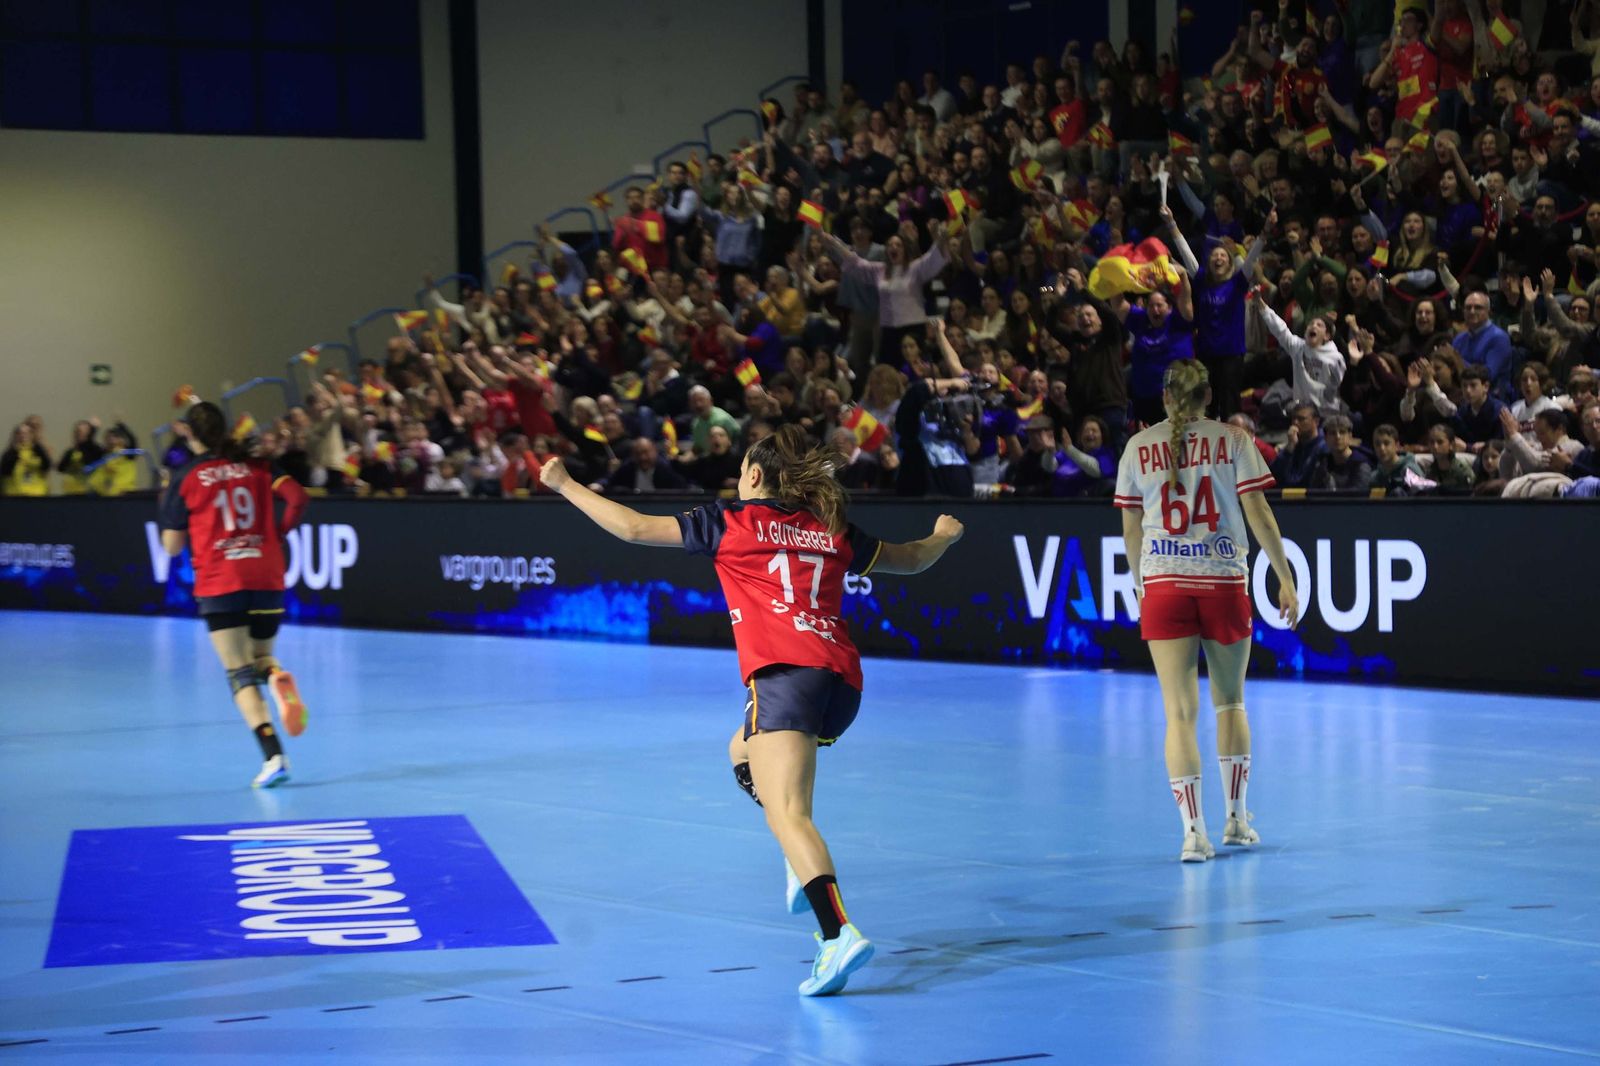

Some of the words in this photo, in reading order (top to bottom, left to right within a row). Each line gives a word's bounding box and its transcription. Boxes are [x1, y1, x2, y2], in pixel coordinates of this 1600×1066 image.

[213, 487, 256, 531] 19
[1161, 476, 1220, 535] 64
[757, 520, 768, 543] J.
[769, 521, 838, 554] GUTIÉRREZ
[1150, 539, 1212, 557] Allianz
[767, 549, 825, 610] 17
[1012, 535, 1428, 635] VAROUP
[177, 820, 423, 946] VARGROUP
